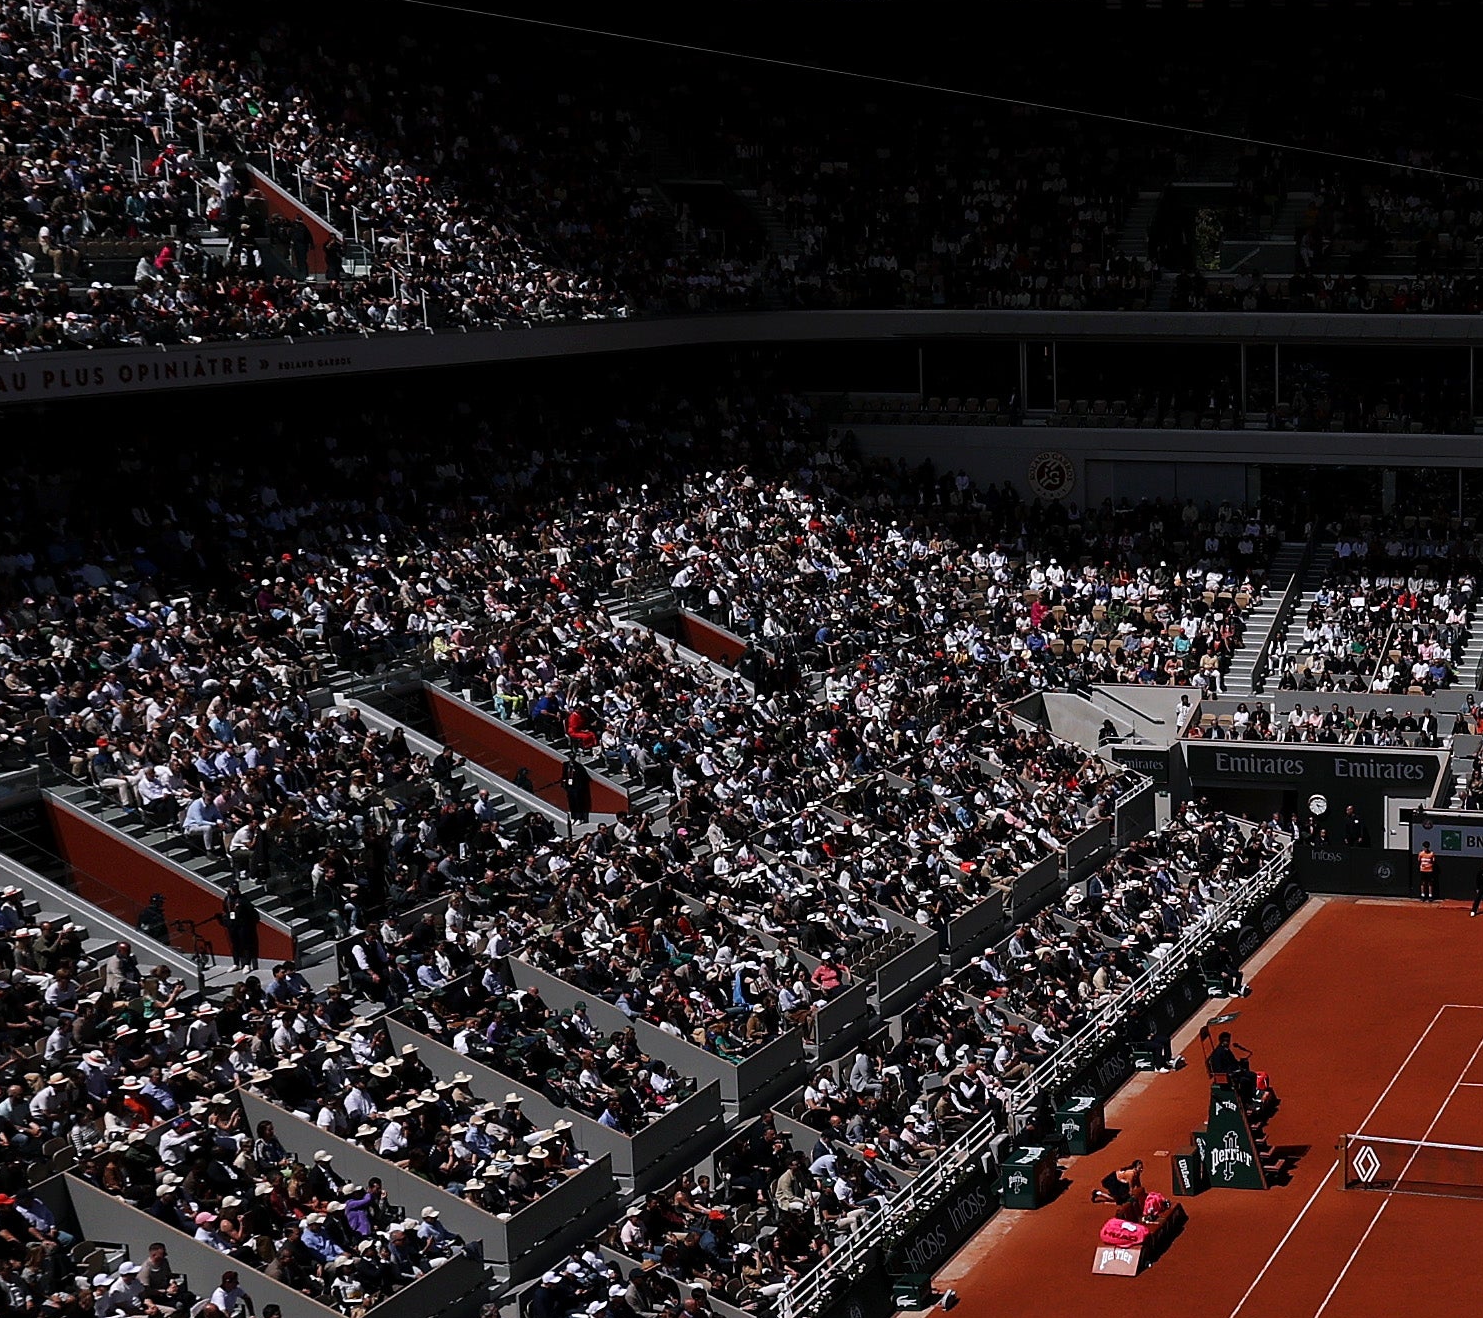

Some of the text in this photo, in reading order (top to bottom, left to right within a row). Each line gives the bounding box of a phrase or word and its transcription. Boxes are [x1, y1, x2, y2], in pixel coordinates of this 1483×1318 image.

[43, 367, 104, 388] PLUS
[119, 355, 248, 382] OPINIÂTRE
[278, 360, 315, 370] ROLAND
[1216, 752, 1304, 776] Emirates
[1334, 757, 1425, 781] Emirates
[1311, 848, 1343, 864] Infosys
[947, 1184, 988, 1233] Infosys
[903, 1222, 947, 1275] Infosys
